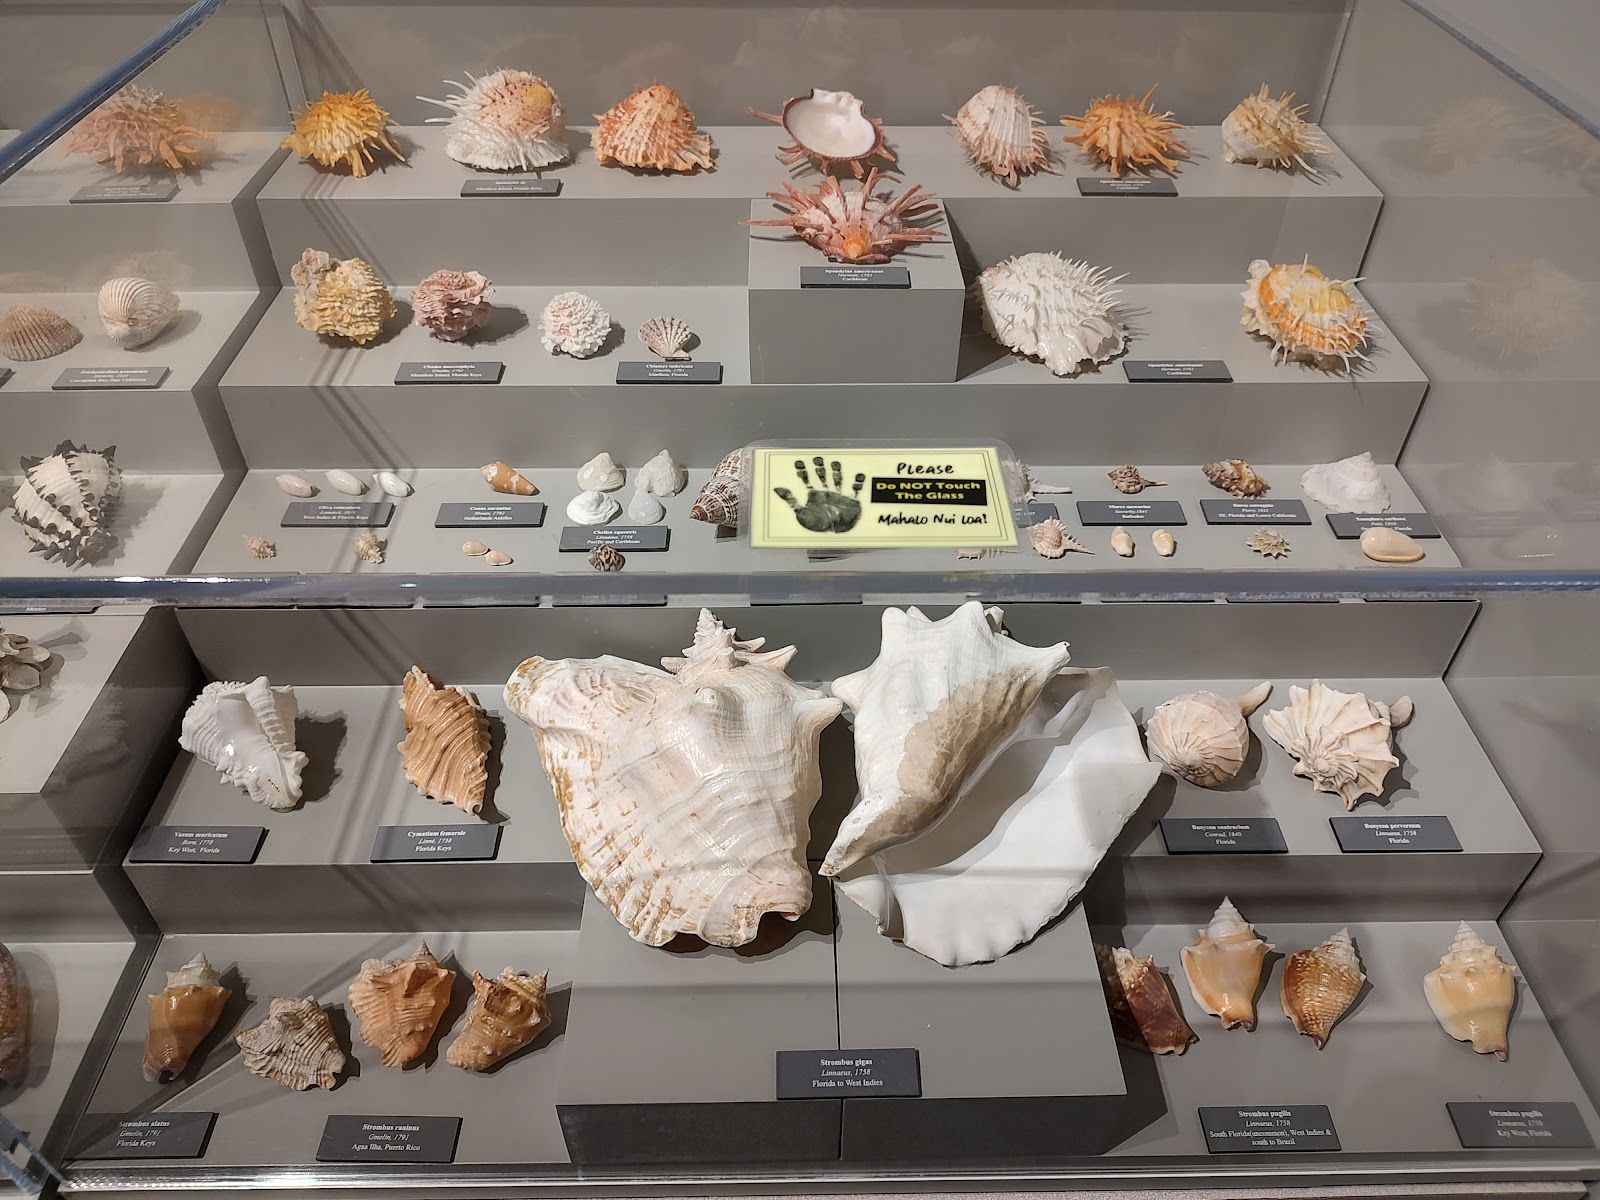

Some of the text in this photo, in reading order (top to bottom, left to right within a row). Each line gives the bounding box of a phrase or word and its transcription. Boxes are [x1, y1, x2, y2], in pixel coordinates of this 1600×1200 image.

[896, 462, 954, 474] Please
[878, 512, 928, 526] Mahalo
[934, 514, 956, 524] Nui
